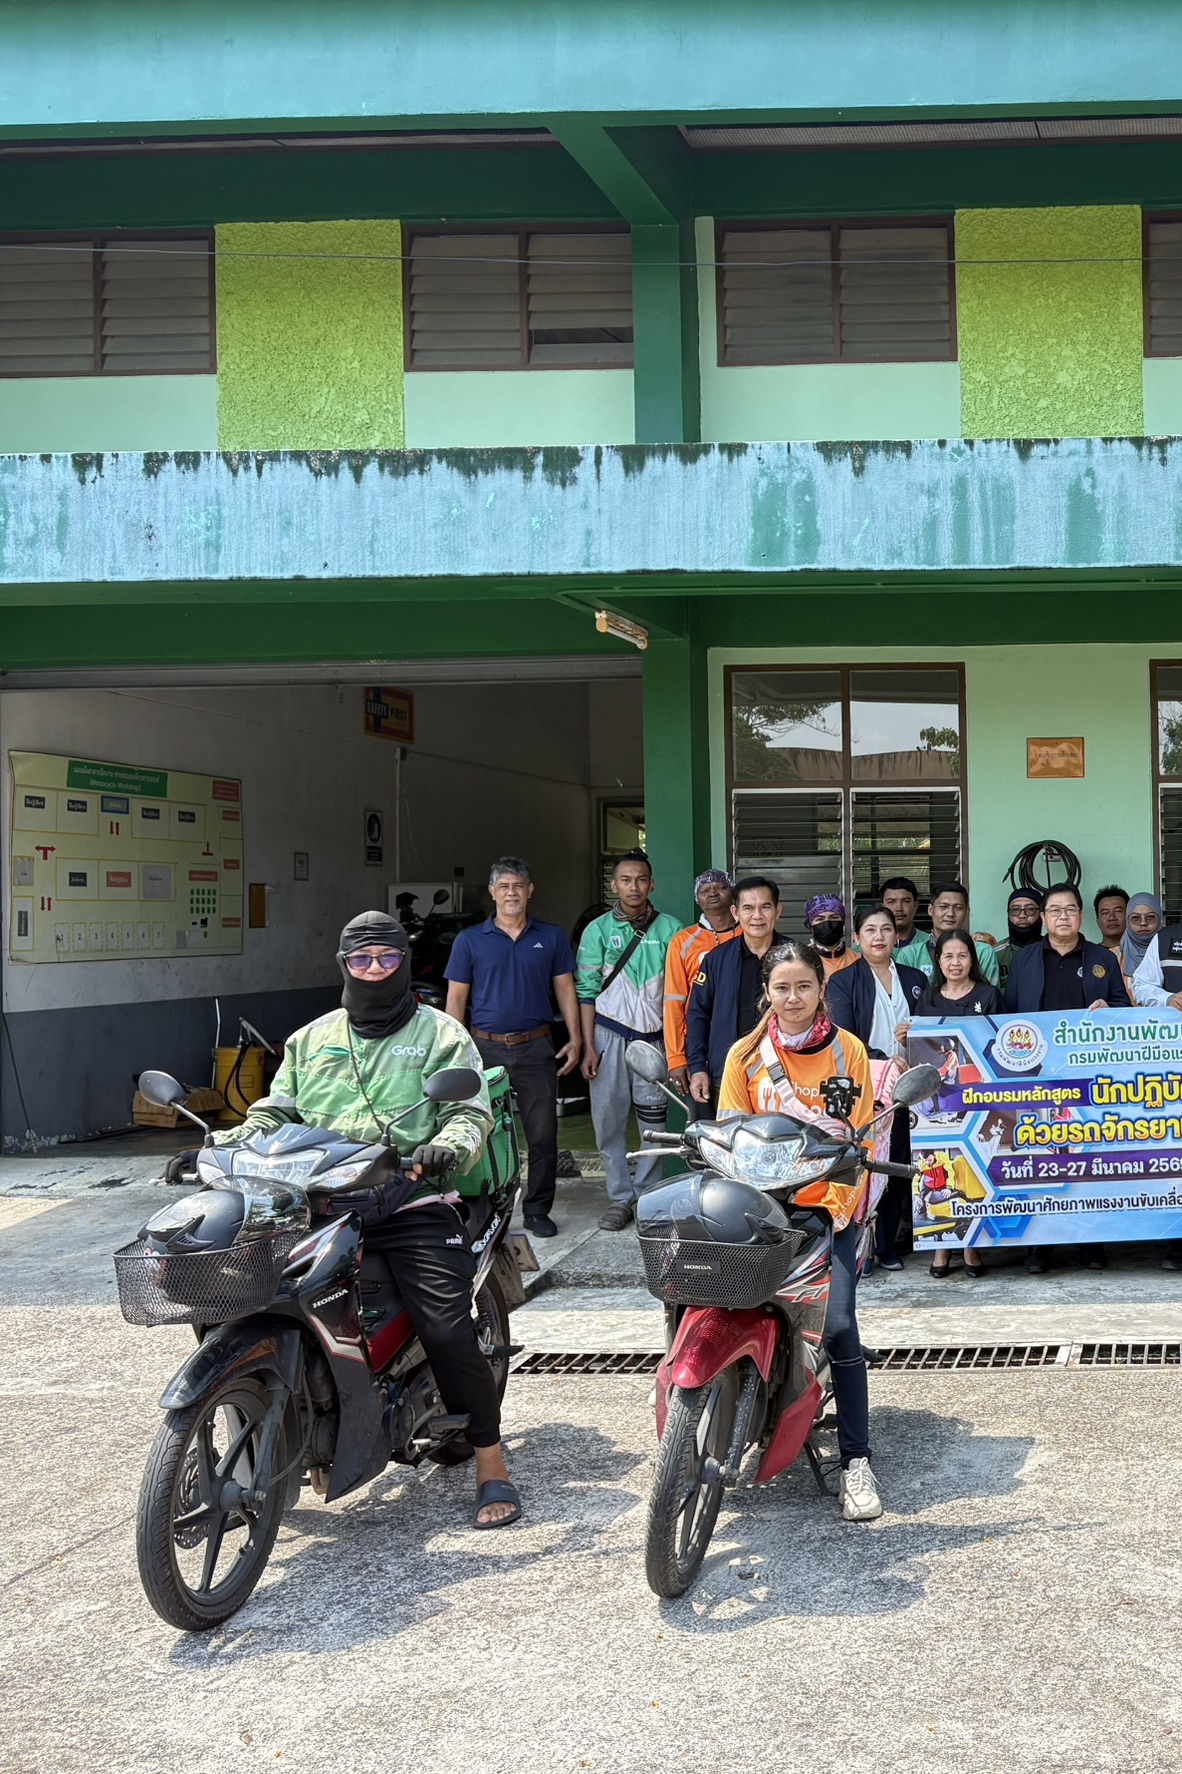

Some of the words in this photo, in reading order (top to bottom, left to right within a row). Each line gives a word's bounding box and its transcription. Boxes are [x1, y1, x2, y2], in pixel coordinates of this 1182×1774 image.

[390, 1045, 427, 1057] Grab
[962, 1086, 1082, 1105] ฝึกอบรมหลักสูตร
[1001, 1155, 1034, 1179] วันที่
[1038, 1160, 1087, 1177] 23-27
[1091, 1158, 1145, 1175] มีนาคม
[312, 1288, 349, 1309] HONDA
